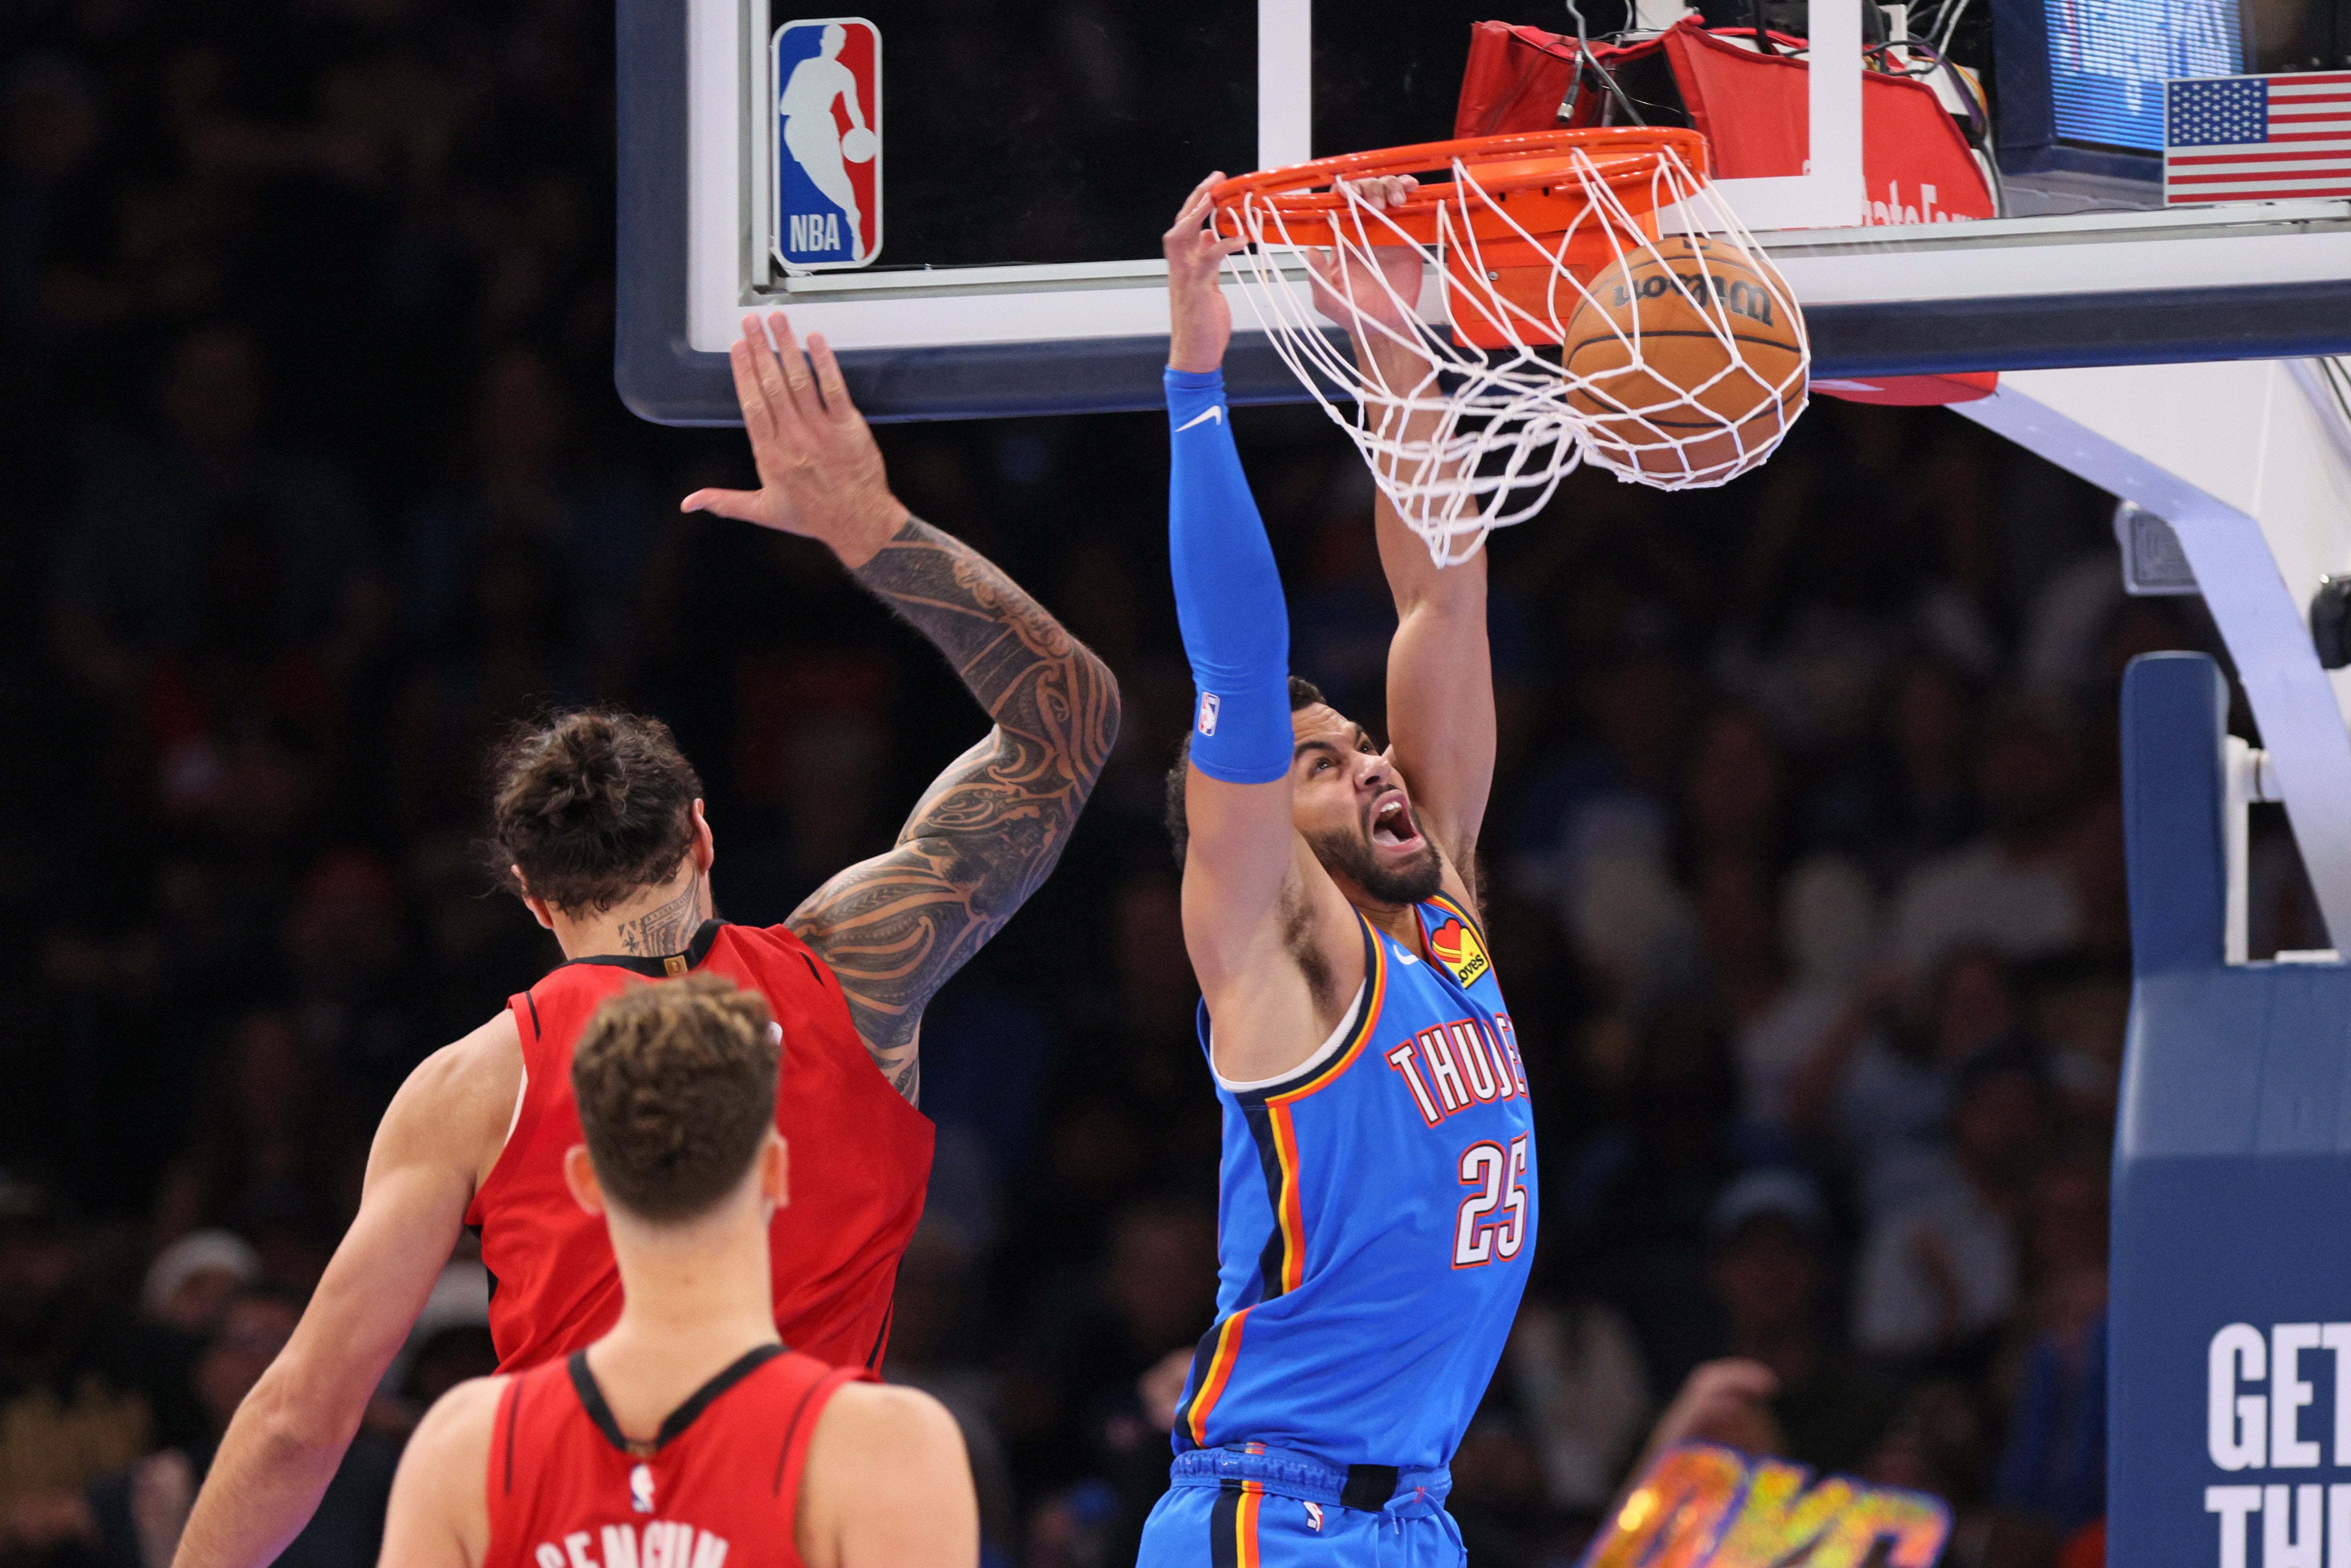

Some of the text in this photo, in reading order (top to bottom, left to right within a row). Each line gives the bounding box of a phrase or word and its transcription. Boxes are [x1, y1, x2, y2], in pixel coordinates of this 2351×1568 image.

[790, 213, 841, 252] NBA
[1612, 273, 1774, 328] Wilson
[1451, 1130, 1529, 1270] 25
[2208, 1321, 2351, 1472] GET
